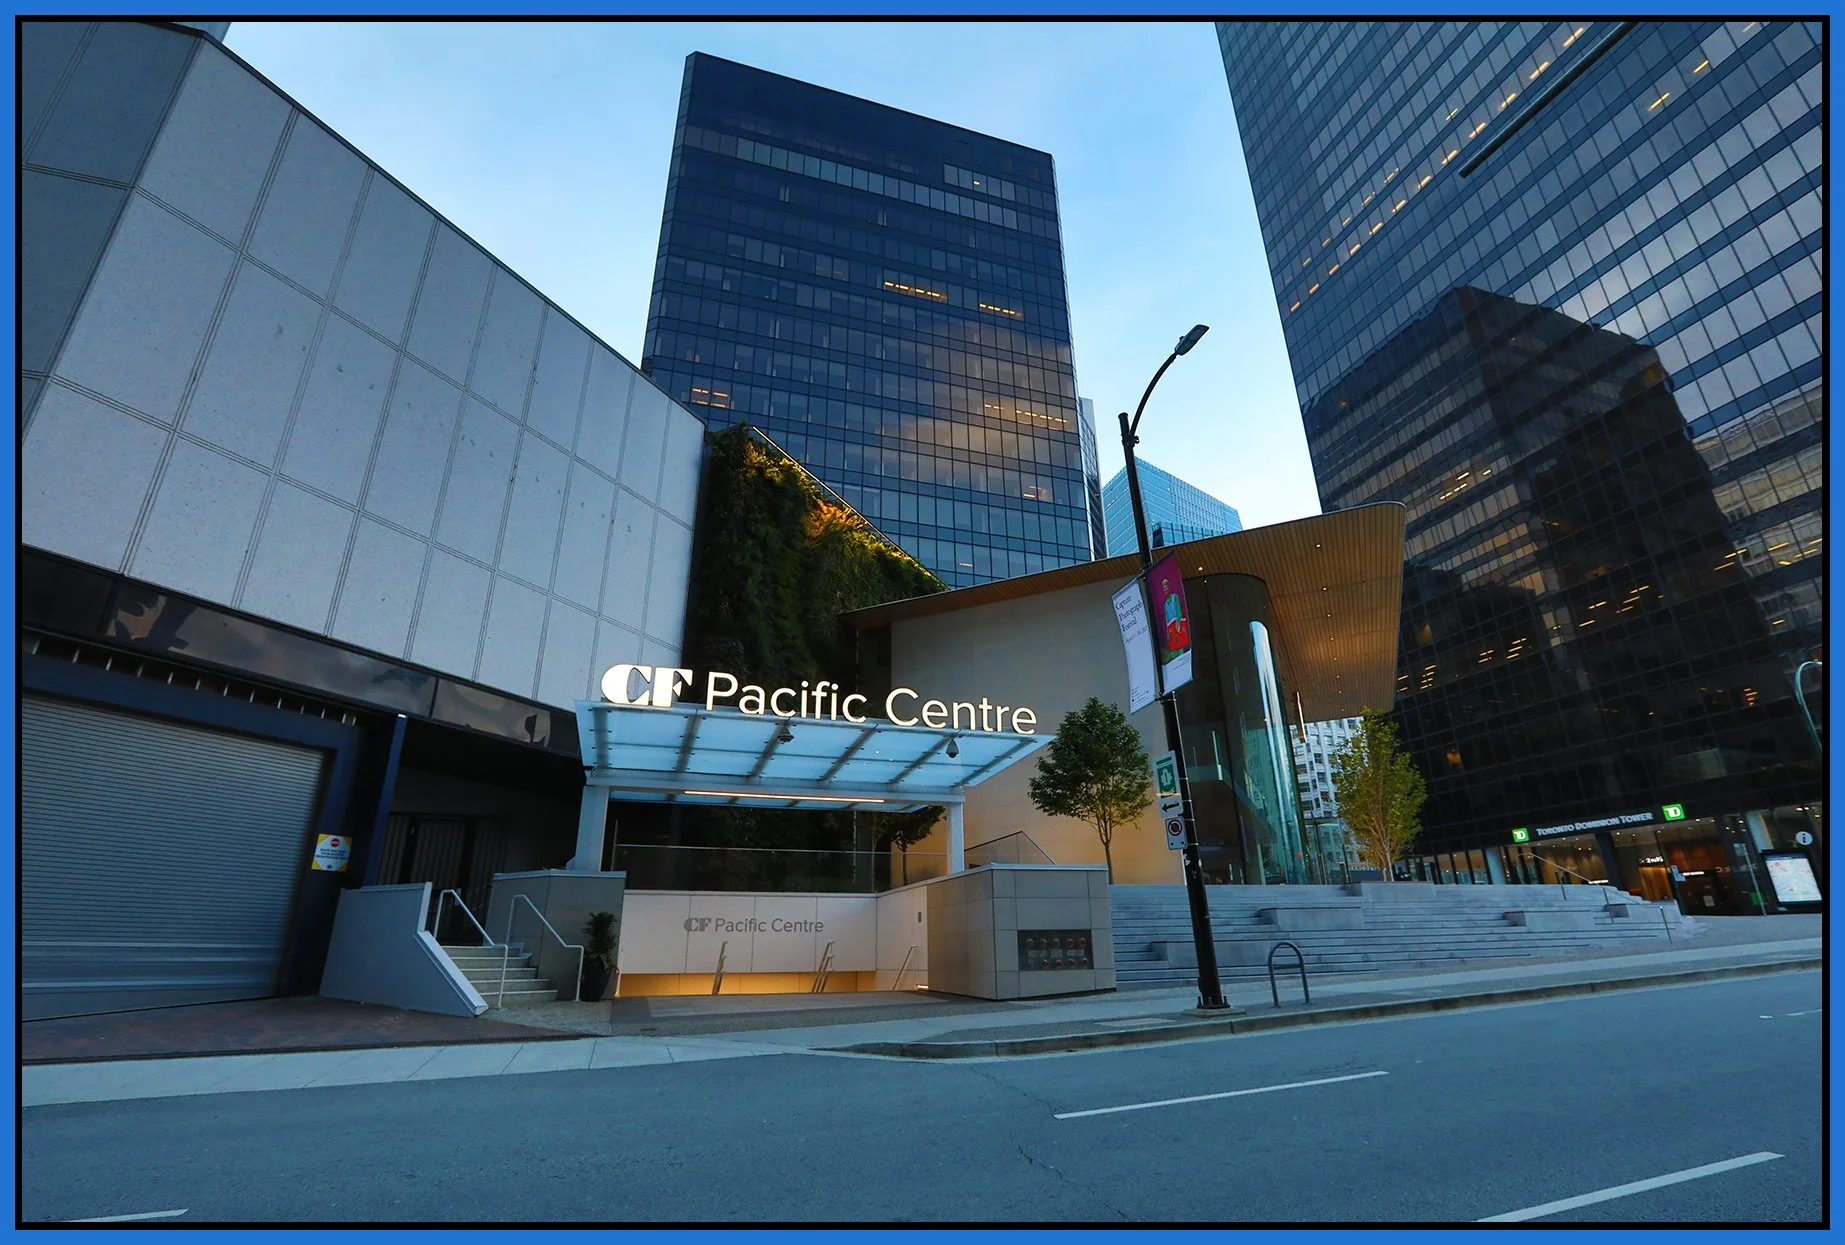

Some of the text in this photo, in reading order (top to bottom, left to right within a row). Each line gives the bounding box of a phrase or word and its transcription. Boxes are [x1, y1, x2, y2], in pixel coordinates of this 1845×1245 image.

[1118, 600, 1144, 621] Photograph
[601, 663, 1037, 736] CF Pacific Centre
[1663, 805, 1682, 819] TD
[1513, 812, 1654, 841] TD TORONTO DOMINION TOWER
[683, 917, 824, 933] CF Pacific Centre
